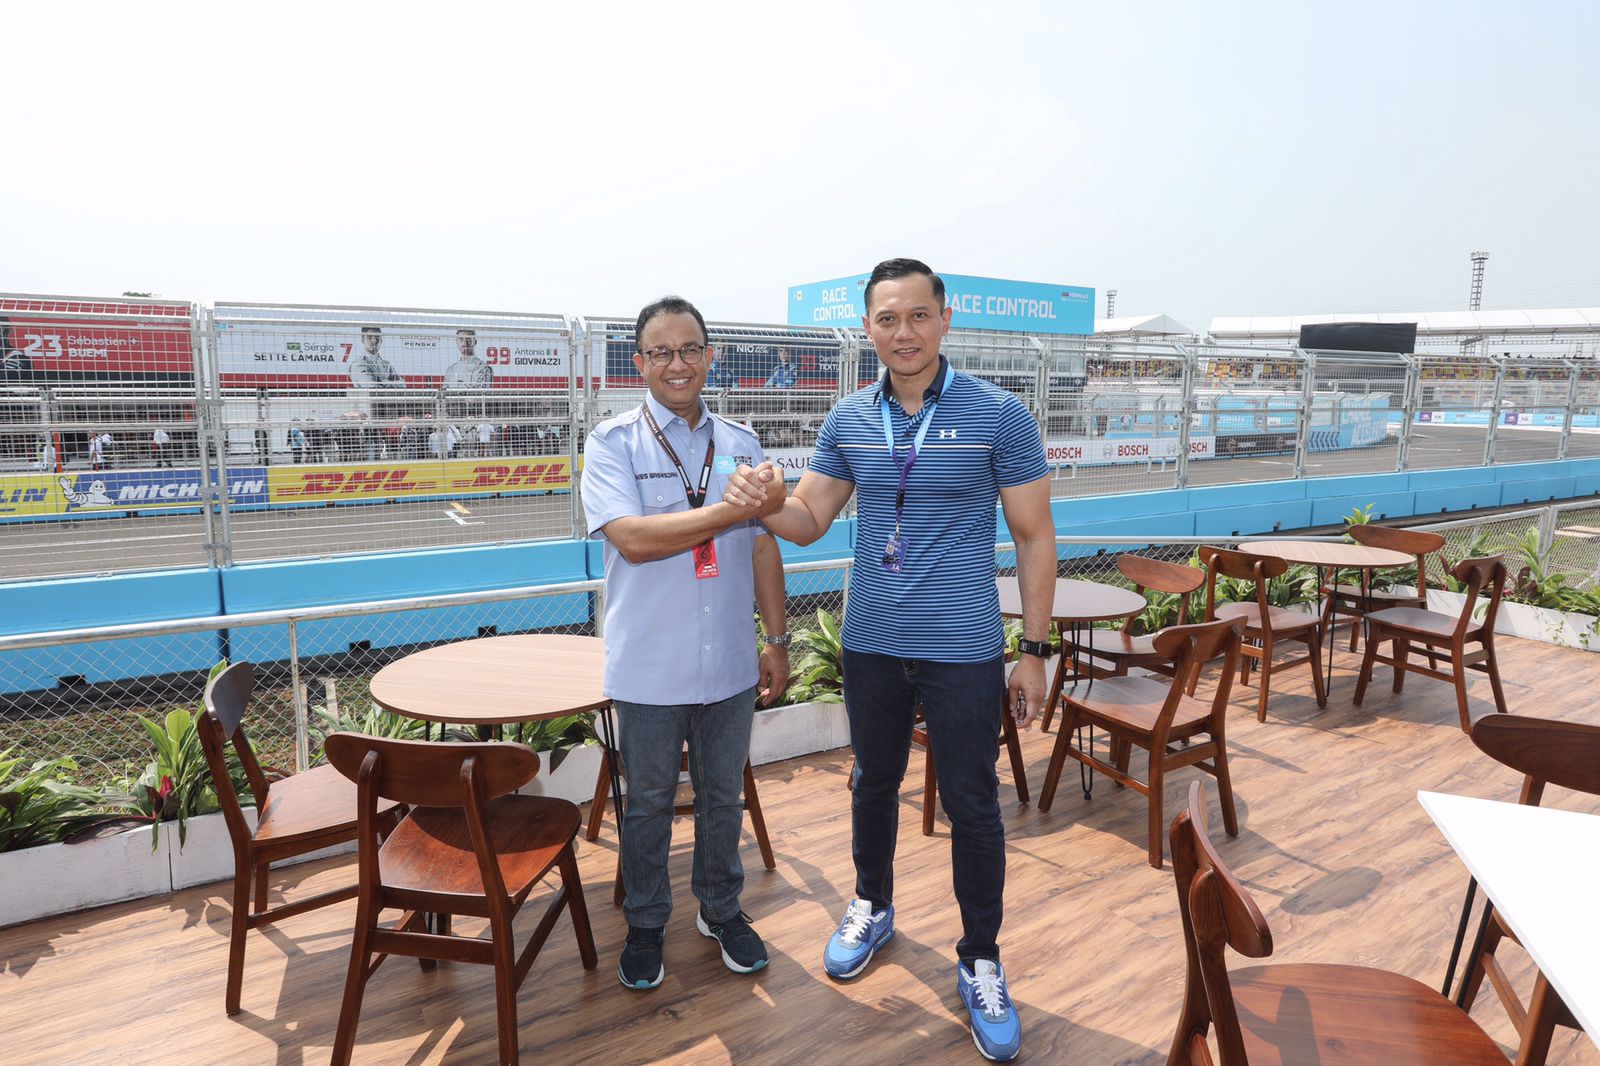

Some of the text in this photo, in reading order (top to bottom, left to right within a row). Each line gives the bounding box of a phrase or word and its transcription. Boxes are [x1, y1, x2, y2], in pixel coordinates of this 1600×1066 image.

[822, 286, 848, 304] RACE
[814, 304, 857, 321] CONTROL
[986, 296, 1057, 319] CONTROL
[24, 335, 62, 357] 23
[340, 343, 352, 363] 7
[514, 347, 545, 356] Antonio
[254, 353, 288, 362] SETTE
[486, 347, 511, 365] 99
[514, 357, 561, 366] GIOVINAZZI
[1047, 447, 1082, 460] BOSCH
[1117, 444, 1149, 456] BOSCH
[302, 470, 417, 494] DHL
[472, 463, 571, 487] DHL
[118, 480, 264, 499] MICHIN
